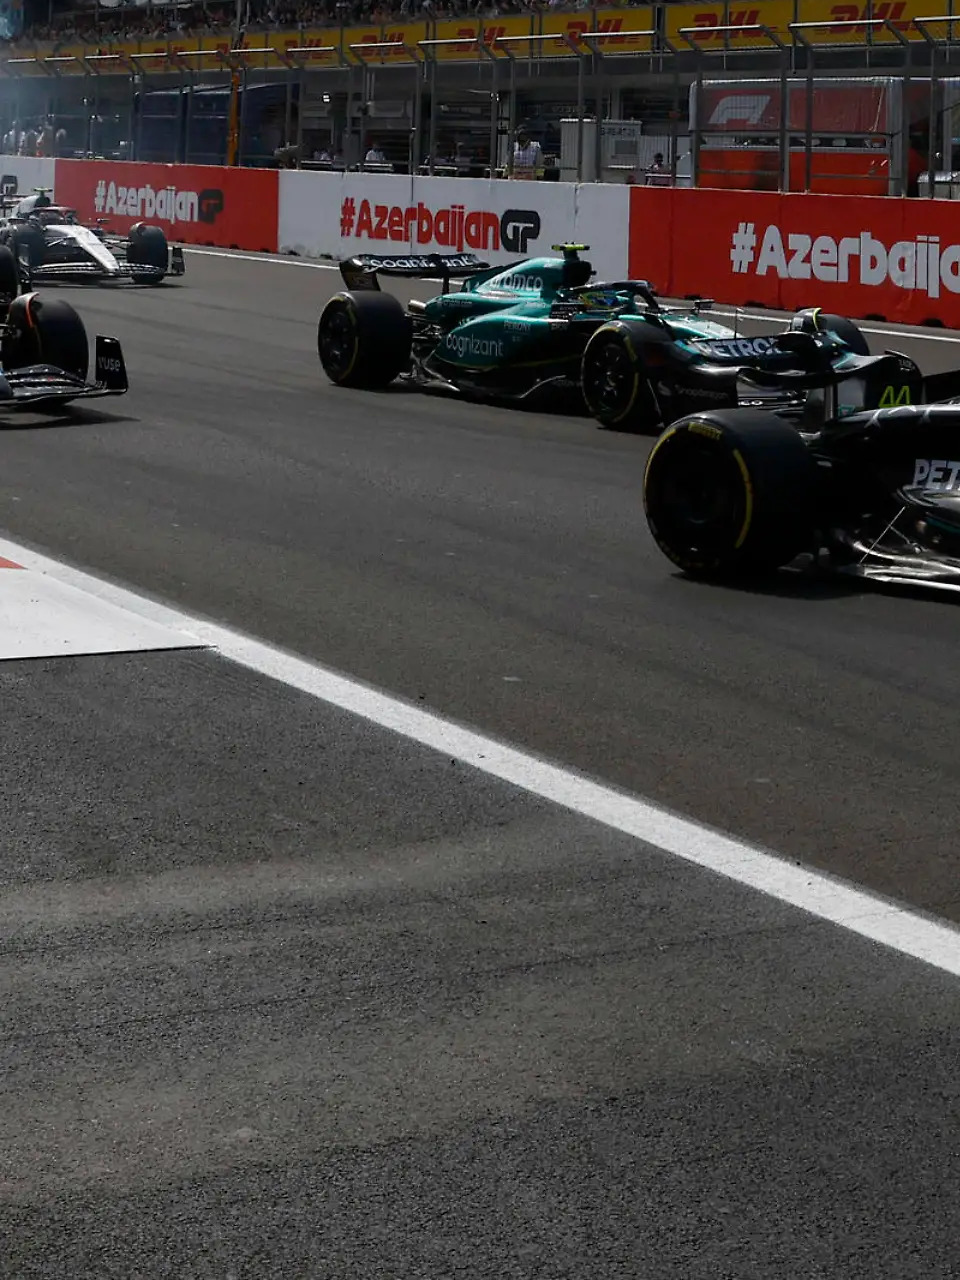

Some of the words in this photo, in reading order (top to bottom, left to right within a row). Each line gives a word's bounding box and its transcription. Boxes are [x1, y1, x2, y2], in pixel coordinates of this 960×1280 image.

[693, 10, 761, 40] DHL
[829, 2, 912, 34] DHL
[457, 26, 508, 52] DHL
[567, 18, 626, 45] DHL
[369, 254, 479, 269] cogniant
[446, 332, 505, 358] cognizant
[878, 384, 911, 408] 44
